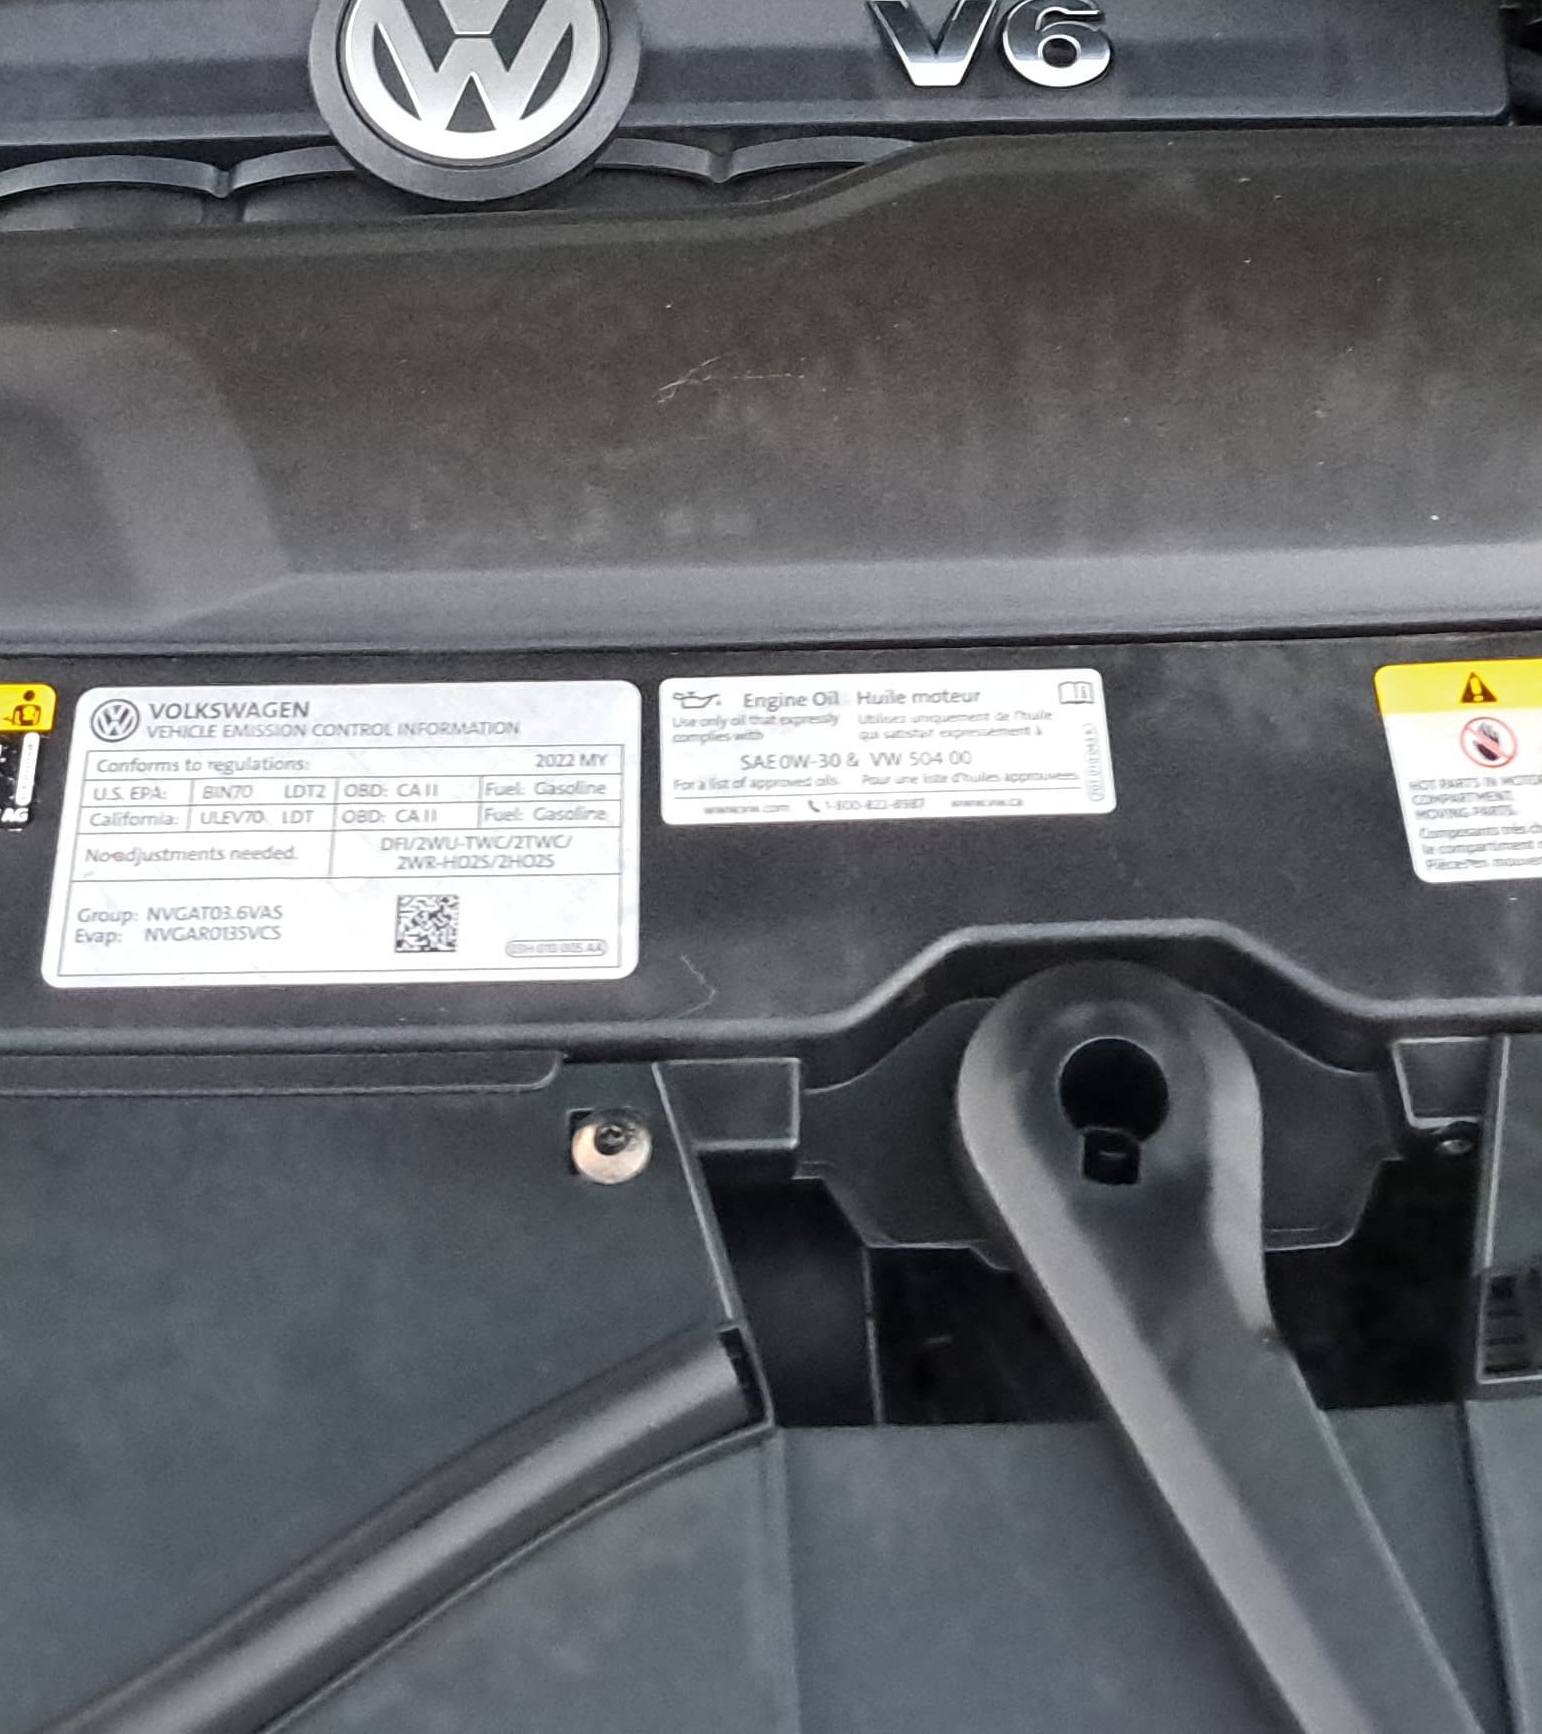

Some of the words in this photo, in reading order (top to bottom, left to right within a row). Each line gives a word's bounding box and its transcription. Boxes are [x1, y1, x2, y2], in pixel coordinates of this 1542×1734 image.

[744, 692, 808, 712] Engine
[812, 691, 839, 706] Oil
[857, 690, 906, 705] Huile
[912, 690, 981, 704] moteur
[149, 701, 310, 720] VOLKSWAGEN
[147, 724, 217, 739] VEHICLE
[222, 723, 308, 738] EMISSION
[312, 722, 392, 737] CONTROL
[398, 721, 521, 736] INFORMATION
[672, 717, 697, 728] Use
[699, 716, 727, 729] only
[96, 758, 179, 773] Conforms
[184, 757, 202, 771] to
[208, 757, 309, 775] regulations:
[535, 754, 575, 768] 2022
[579, 753, 608, 767] MY
[740, 755, 775, 770] SAE
[778, 752, 841, 769] 0W-30
[845, 752, 859, 767] &
[870, 751, 903, 767] VW
[909, 751, 943, 766] 504
[948, 750, 973, 765] 00
[130, 786, 167, 800] EPA:
[202, 785, 253, 799] BIN70
[284, 784, 326, 798] LDT2
[344, 784, 387, 798] OBD:
[396, 783, 422, 797] CA
[485, 782, 525, 796] Fuel:
[534, 781, 606, 796] Gasoline
[1, 807, 29, 822] AG
[90, 813, 179, 827] California:
[200, 811, 264, 825] ULEV70
[282, 810, 314, 824] LDT
[341, 809, 386, 824] OBD:
[395, 809, 421, 823] CA
[484, 807, 524, 822] Fuel:
[533, 807, 606, 821] Gasoline
[85, 848, 108, 862] No
[110, 846, 225, 866] adjustments
[230, 845, 298, 860] needed.
[77, 908, 139, 926] Group:
[146, 905, 283, 922] NVGAT03.6VAS
[75, 929, 122, 946] Evap:
